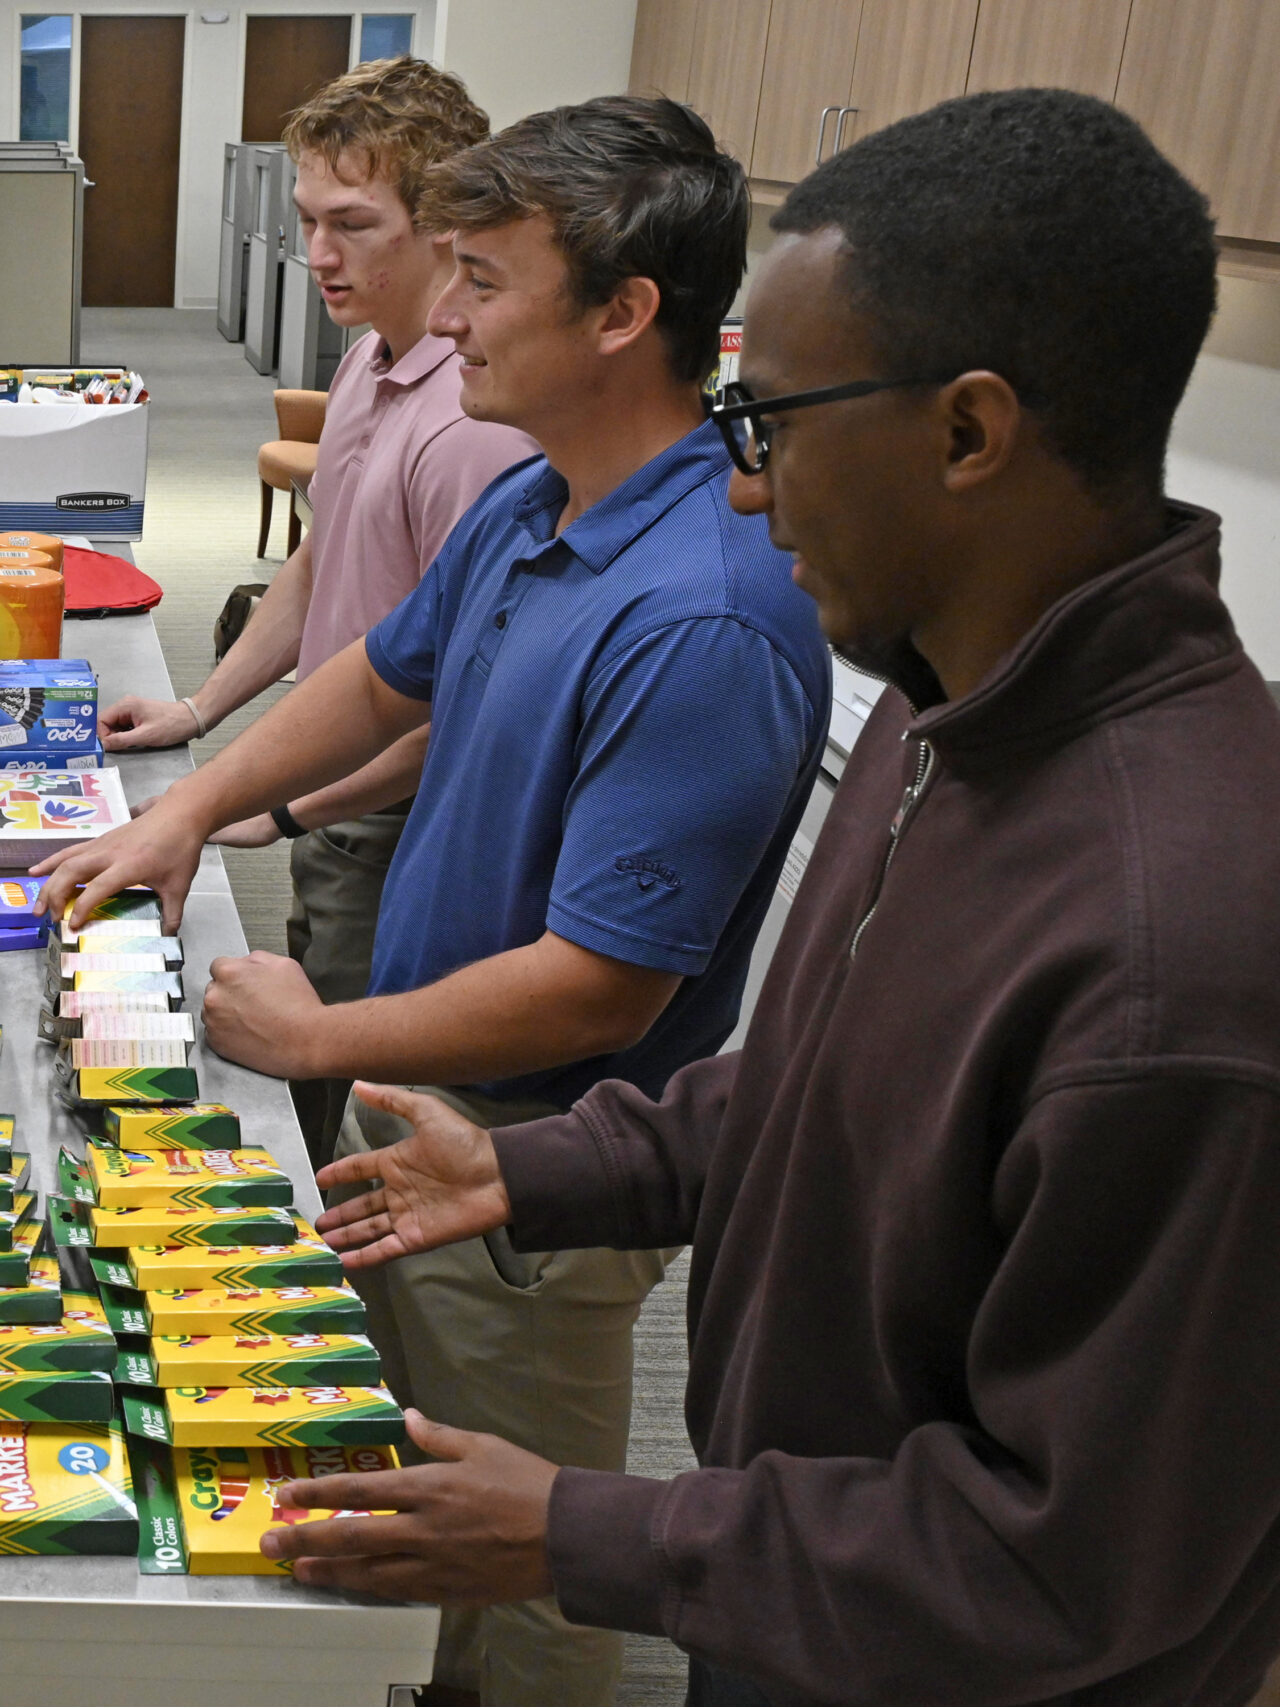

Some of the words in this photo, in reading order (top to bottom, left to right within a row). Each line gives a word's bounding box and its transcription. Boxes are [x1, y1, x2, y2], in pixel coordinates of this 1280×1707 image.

[60, 498, 104, 507] BANKERS
[106, 497, 126, 506] BOX
[47, 722, 93, 742] EXPO
[102, 1150, 128, 1175] Crayola
[202, 1150, 247, 1176] MARKERS
[70, 1236, 90, 1246] 10
[110, 1276, 131, 1286] 10
[68, 1310, 88, 1319] 10
[124, 1309, 134, 1322] Classic
[133, 1311, 144, 1324] Colors
[124, 1321, 146, 1332] 10
[127, 1357, 138, 1371] Classic
[138, 1359, 150, 1374] Colors
[129, 1370, 152, 1383] 10
[141, 1407, 152, 1423] Classic
[153, 1408, 165, 1427] Colors
[143, 1425, 167, 1440] 10
[70, 1445, 97, 1472] 20
[359, 1453, 381, 1470] 10
[190, 1448, 219, 1510] Cray
[153, 1516, 165, 1545] Classic
[166, 1517, 177, 1546] Colors
[155, 1548, 182, 1570] 10
